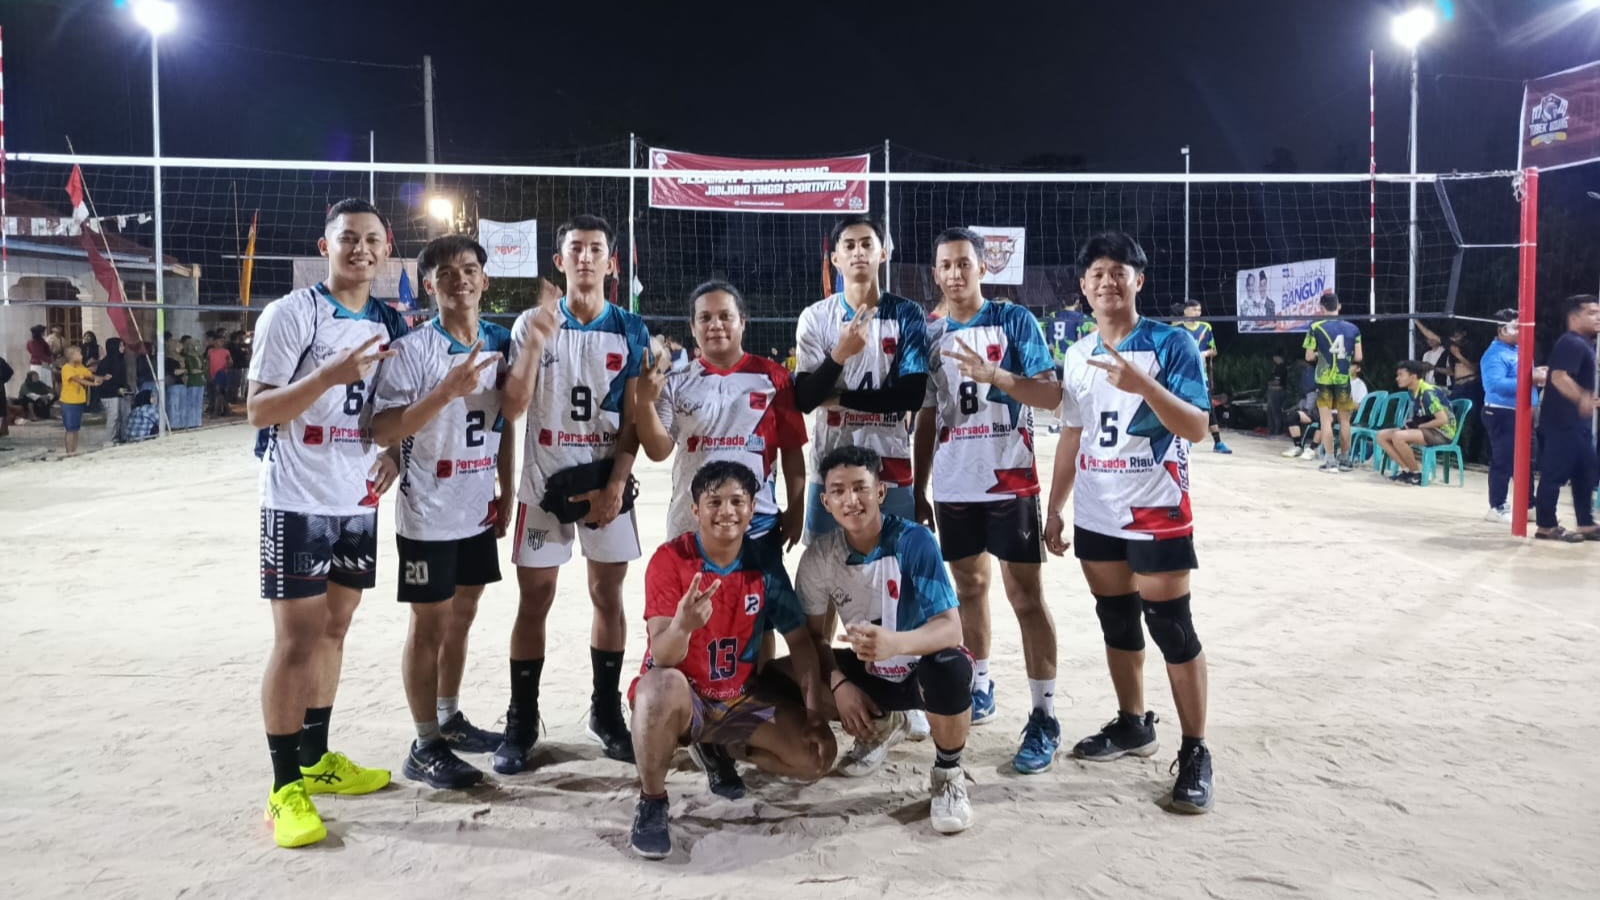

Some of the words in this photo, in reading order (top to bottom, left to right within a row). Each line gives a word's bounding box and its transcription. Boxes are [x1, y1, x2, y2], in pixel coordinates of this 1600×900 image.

[704, 184, 751, 196] JUNJUNG
[752, 182, 784, 195] TINGGI
[785, 180, 847, 194] SPORTIVITAS
[1282, 275, 1326, 310] BANGUN
[1053, 321, 1066, 340] 9
[1329, 335, 1346, 359] 4
[343, 380, 365, 415] 6
[571, 386, 592, 422] 9
[959, 381, 978, 415] 8
[466, 410, 485, 448] 2
[558, 431, 600, 447] Persada
[951, 423, 990, 440] Persada
[992, 421, 1011, 433] Riau
[1099, 411, 1118, 447] 5
[701, 434, 745, 451] Persada
[455, 456, 492, 475] Persada
[1088, 455, 1127, 471] Persada
[1129, 456, 1154, 468] Riau
[405, 560, 429, 585] 20
[707, 637, 738, 681] 13
